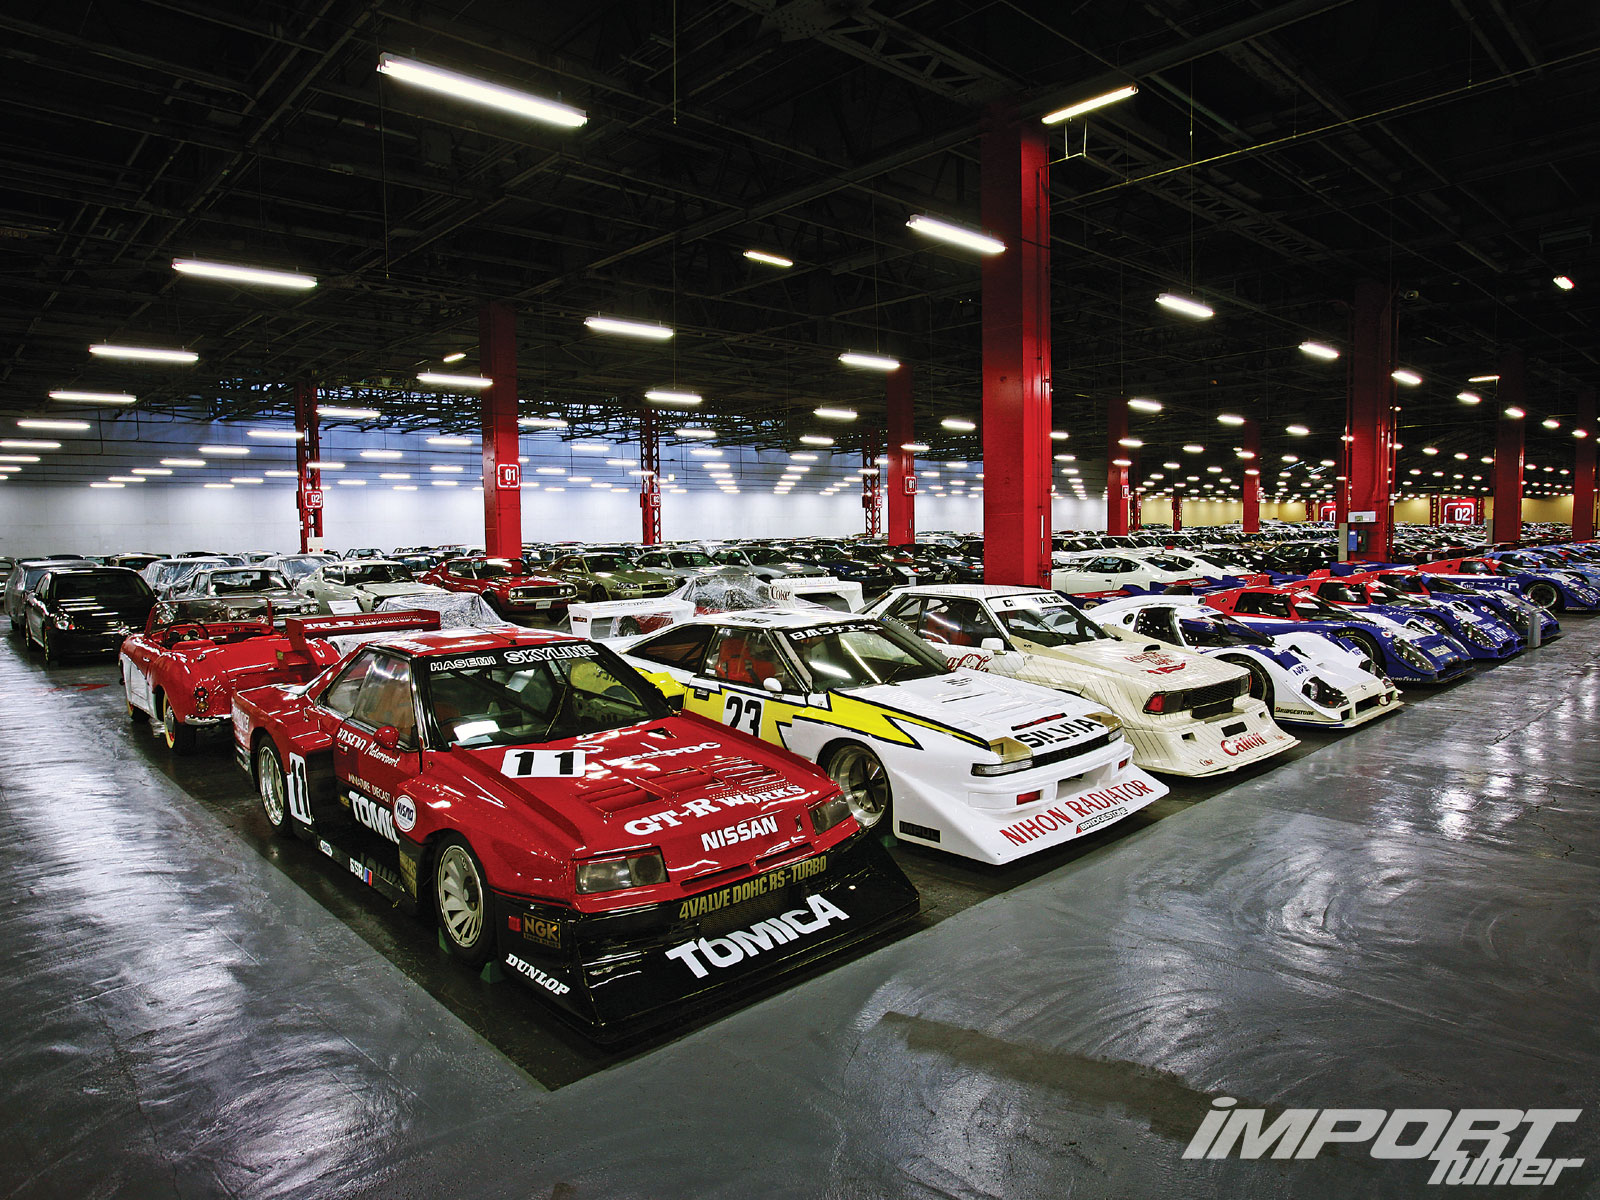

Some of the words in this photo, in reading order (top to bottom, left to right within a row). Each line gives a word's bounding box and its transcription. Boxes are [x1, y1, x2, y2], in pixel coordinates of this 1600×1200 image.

[505, 469, 516, 482] 01
[311, 494, 321, 503] 02
[1454, 507, 1471, 521] 02
[430, 656, 497, 671] HASEMI
[503, 644, 599, 664] SKYLINE
[726, 696, 763, 738] 23
[1014, 718, 1104, 749] SILVIA
[1220, 732, 1268, 757] Canon
[514, 751, 575, 776] 11
[291, 759, 311, 820] 11
[624, 797, 722, 836] GT-R
[714, 784, 806, 807] WORKS
[999, 805, 1075, 847] NIHON
[1064, 779, 1155, 819] RADIATOR
[1079, 806, 1128, 831] BRIDGESTONE
[700, 815, 779, 852] NISSAN
[678, 892, 732, 920] 4VALVE
[732, 875, 769, 905] DOHC
[768, 855, 828, 892] RS-TURBO
[524, 916, 559, 941] NGK
[665, 894, 850, 979] TOMICA
[505, 953, 571, 996] DUNLOP
